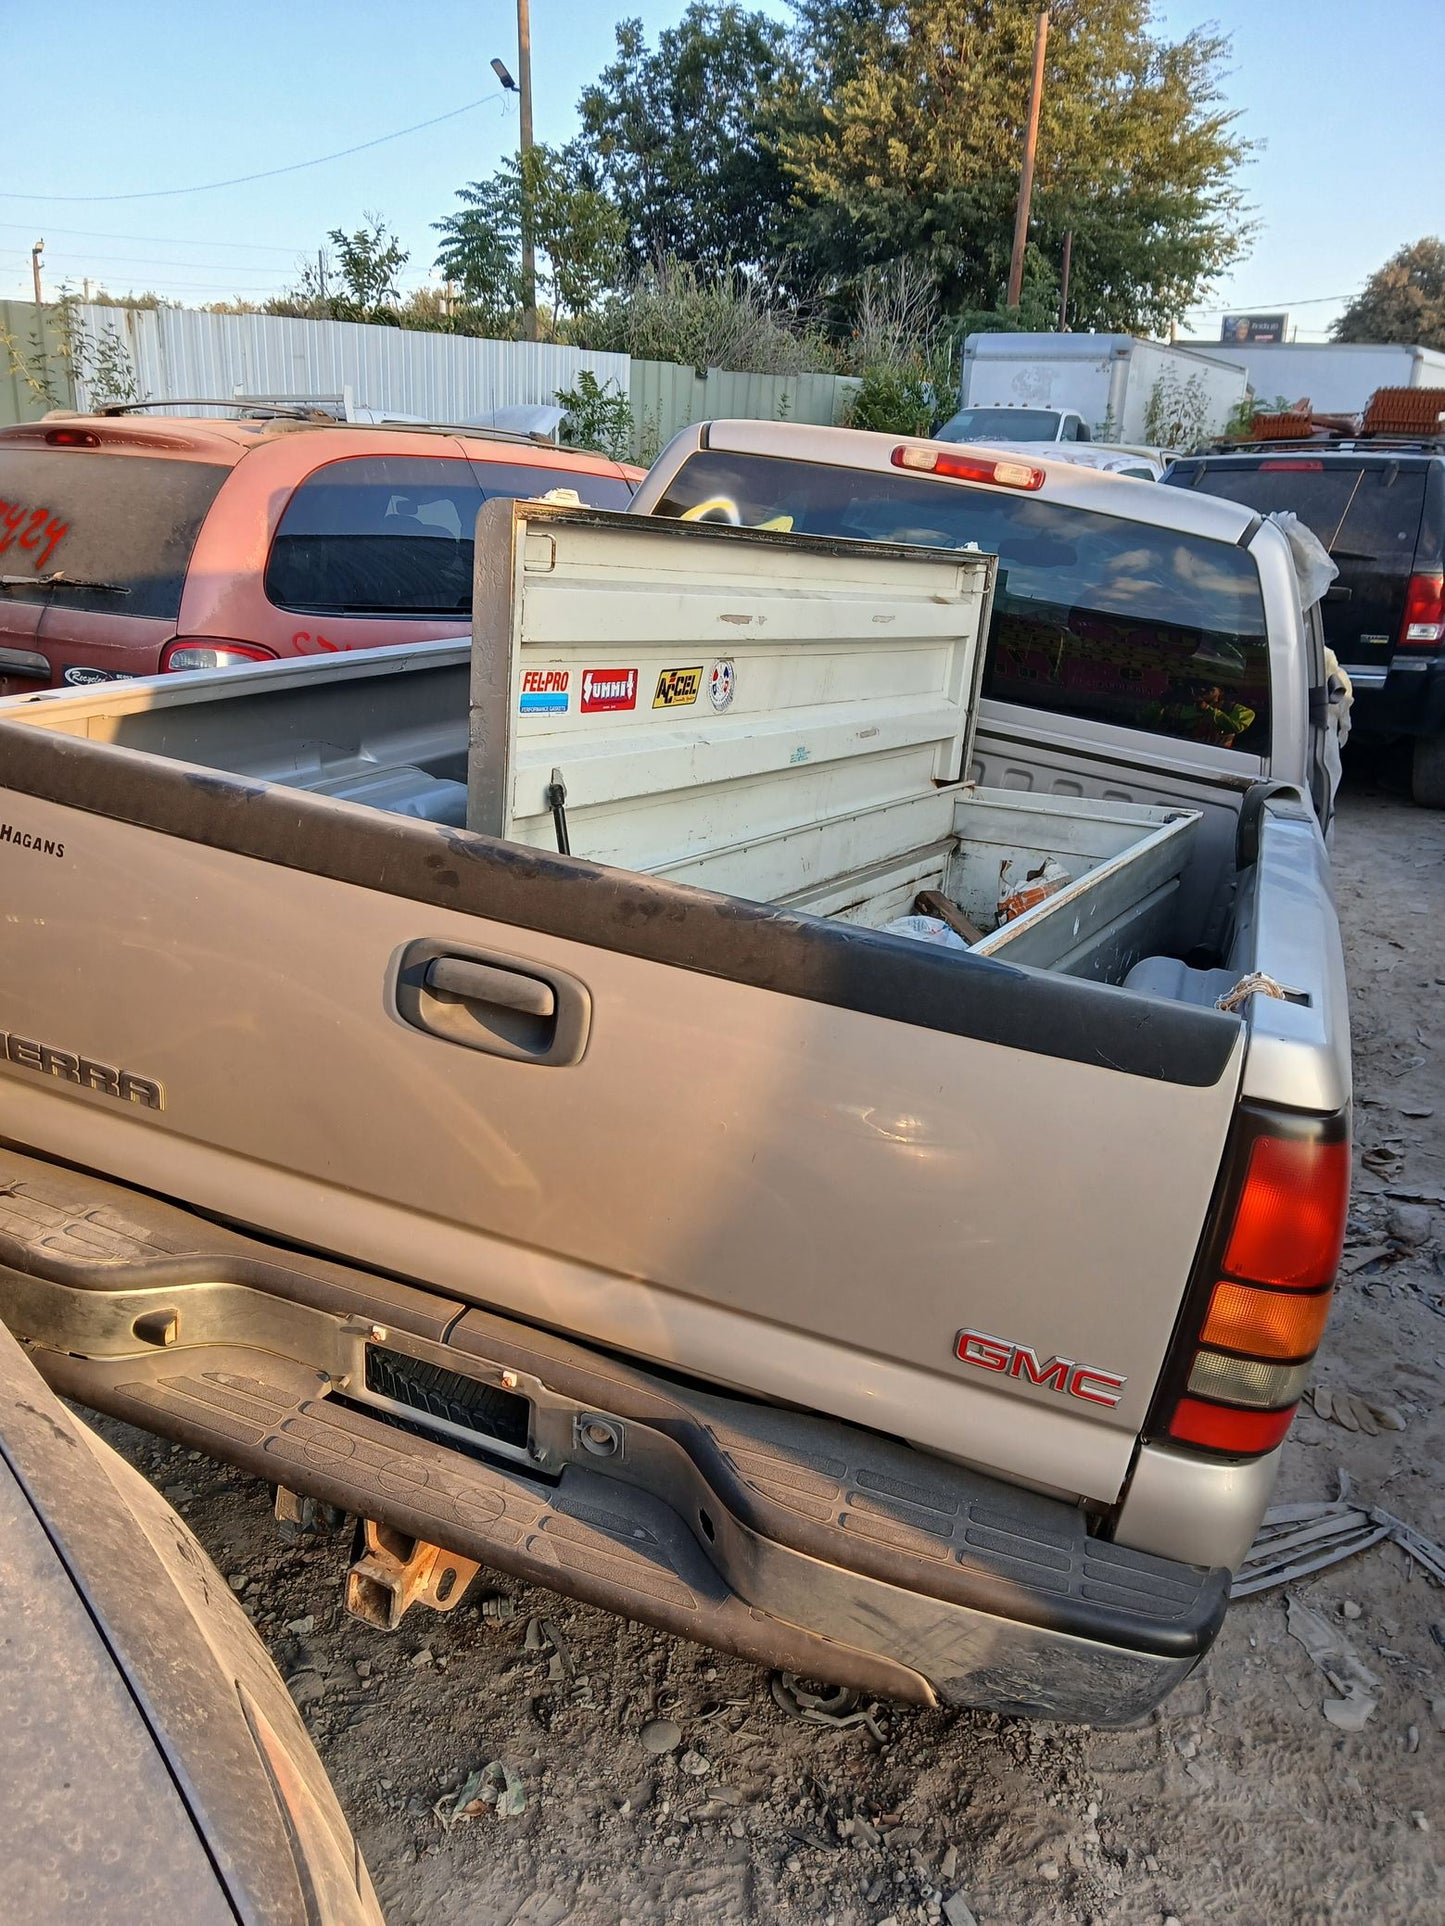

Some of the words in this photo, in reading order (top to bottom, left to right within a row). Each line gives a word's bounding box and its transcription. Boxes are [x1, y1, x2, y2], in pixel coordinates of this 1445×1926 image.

[522, 671, 569, 692] FEL-PRO
[583, 670, 635, 704] SUMMIT
[656, 672, 697, 704] ACCEL
[0, 824, 65, 858] HAGANS
[953, 1327, 1128, 1409] GMC
